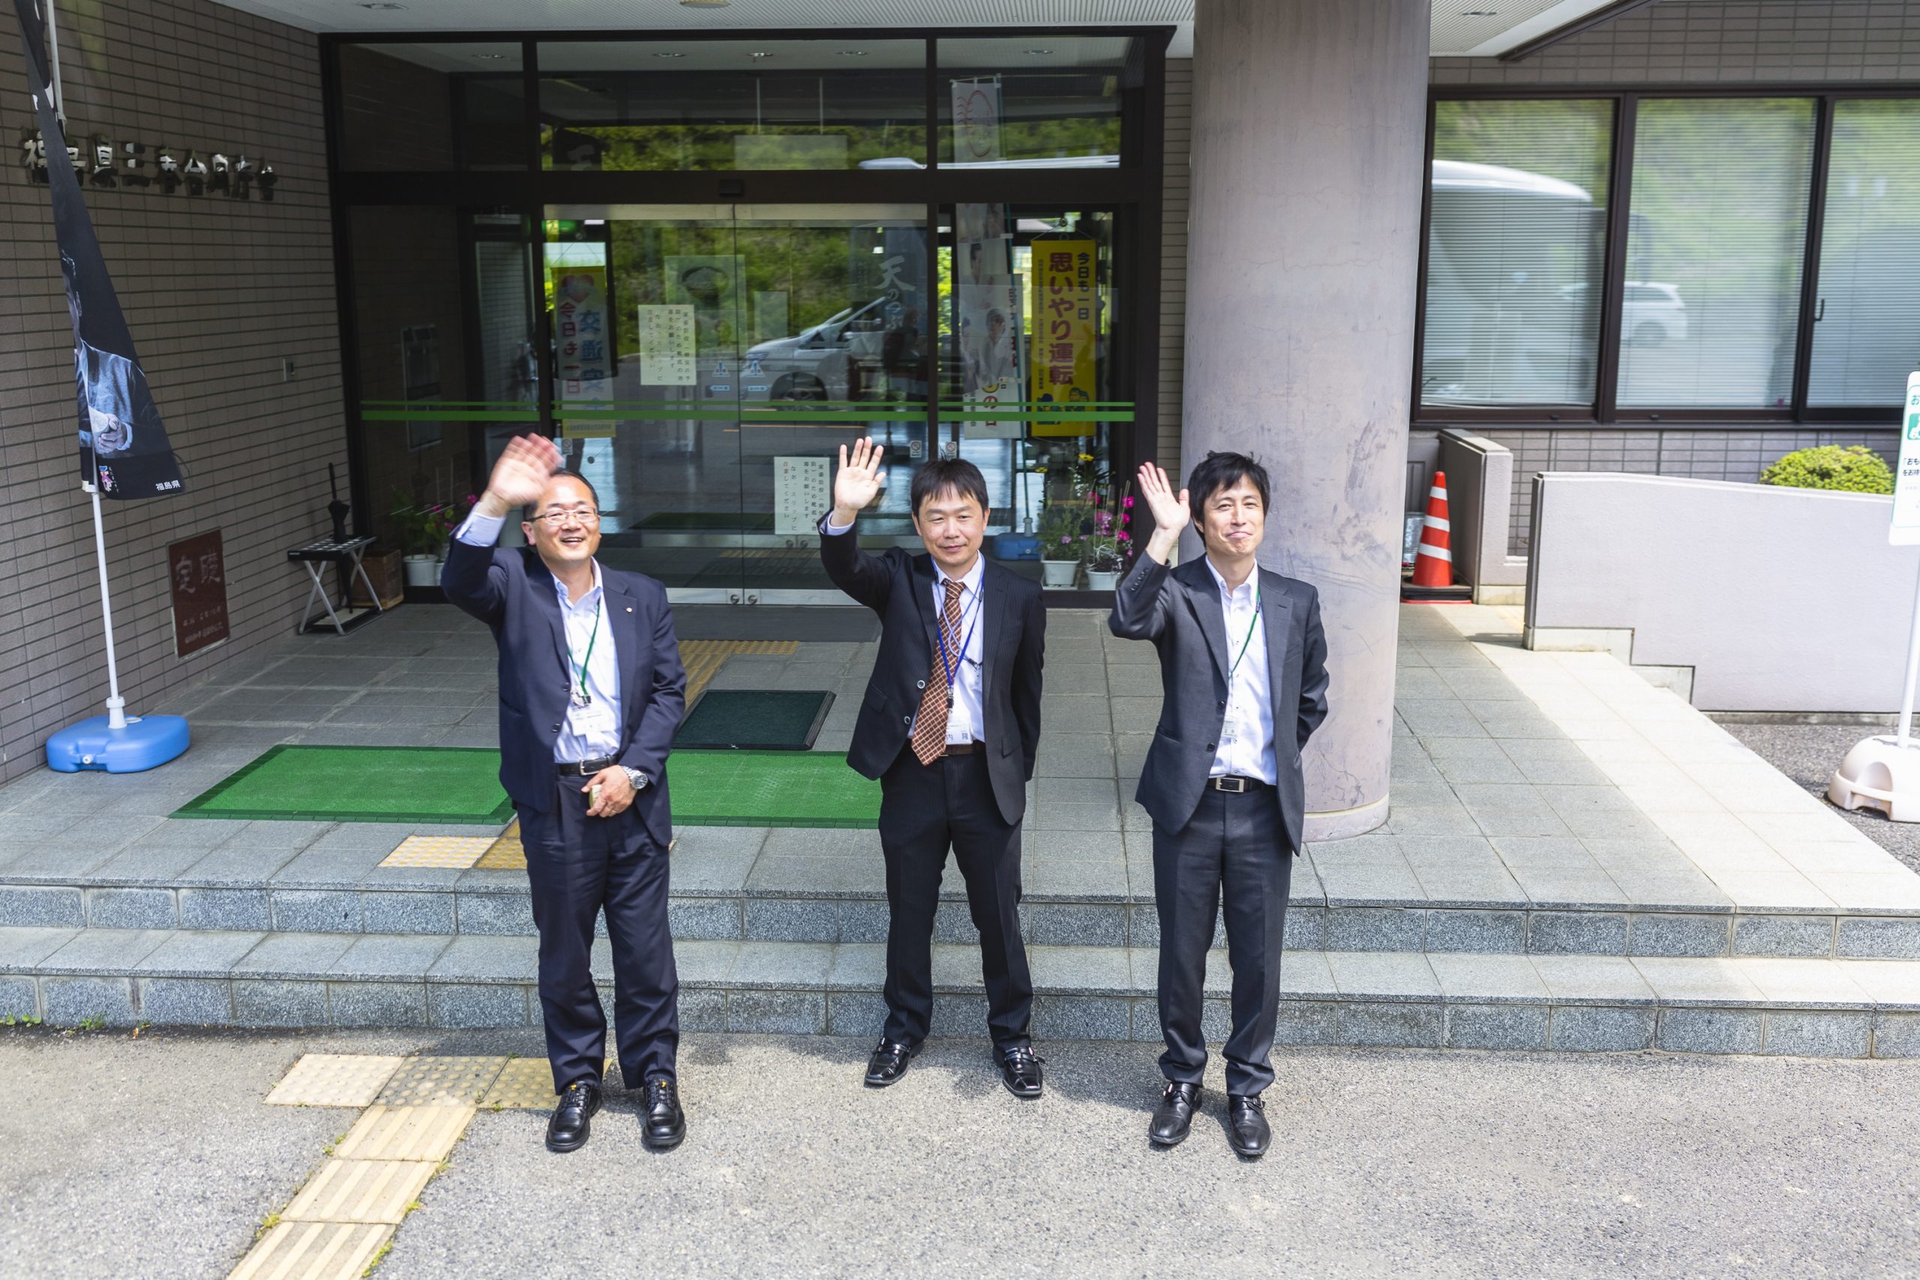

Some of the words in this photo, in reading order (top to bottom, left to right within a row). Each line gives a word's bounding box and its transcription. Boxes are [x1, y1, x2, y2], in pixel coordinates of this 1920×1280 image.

[1048, 252, 1075, 386] 思いやり運転
[1077, 252, 1090, 320] 今日も一日
[155, 479, 181, 491] 福島県
